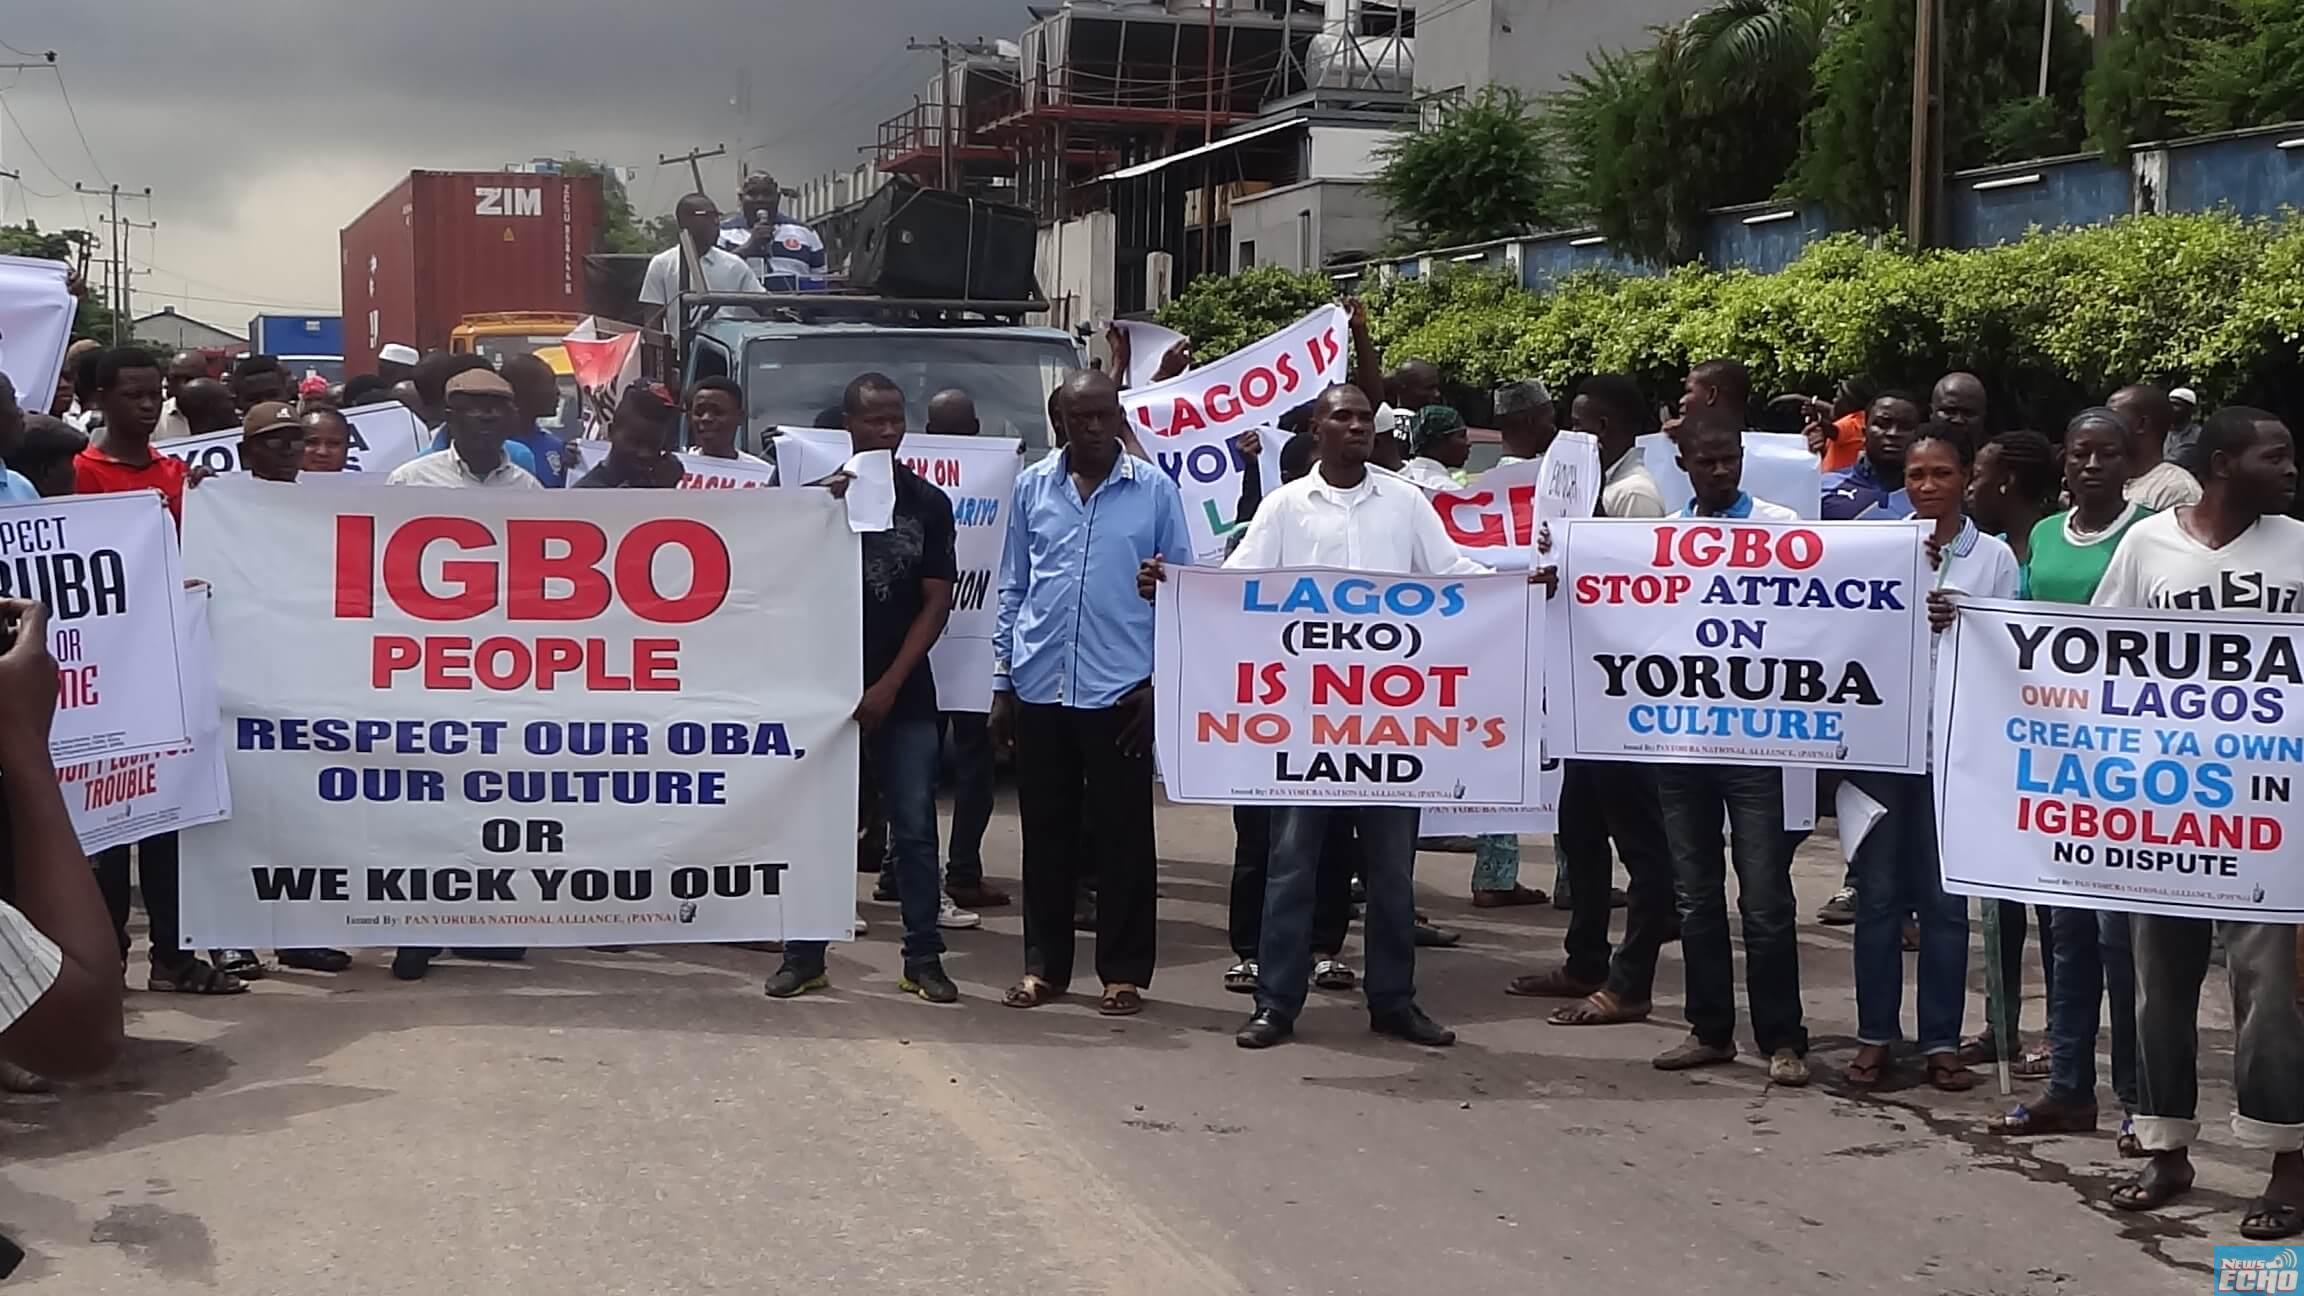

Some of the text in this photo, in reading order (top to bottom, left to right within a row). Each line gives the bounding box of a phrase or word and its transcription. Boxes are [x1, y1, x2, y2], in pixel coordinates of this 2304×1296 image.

[475, 187, 542, 215] ZIM
[1137, 326, 1340, 437] LAGOS IS
[934, 459, 961, 488] ON
[1652, 526, 1824, 569] IGBO
[334, 514, 732, 624] IGBO
[1243, 577, 1465, 617] LAGOS
[1575, 575, 1905, 611] STOP ATTACK
[1282, 621, 1423, 658] (EKO)
[1696, 618, 1767, 650] ON
[2005, 623, 2304, 685] YORUBA
[372, 636, 681, 691] PEOPLE
[1593, 654, 1884, 706] YORUBA
[1237, 662, 1469, 707] IS NOT
[2021, 679, 2285, 724] OWN LAGOS
[236, 716, 806, 761] RESPECT OUR OBA,
[1198, 712, 1506, 749] NO MAN'S
[1628, 704, 1844, 742] CULTURE
[2006, 717, 2304, 763] CREATE YA OWN
[84, 763, 157, 811] TROUBLE
[318, 766, 726, 804] OUR CULTURE
[1276, 751, 1424, 783] LAND
[2016, 748, 2290, 808] LAGOS IN
[482, 818, 563, 853] OR
[2017, 797, 2283, 852] IGBOLAND
[2053, 841, 2239, 877] NO DISPUTE
[252, 862, 788, 901] WE KICK YOU OUT
[405, 914, 429, 925] PAN
[432, 914, 486, 925] YORUBA
[487, 913, 553, 924] NATIONAL
